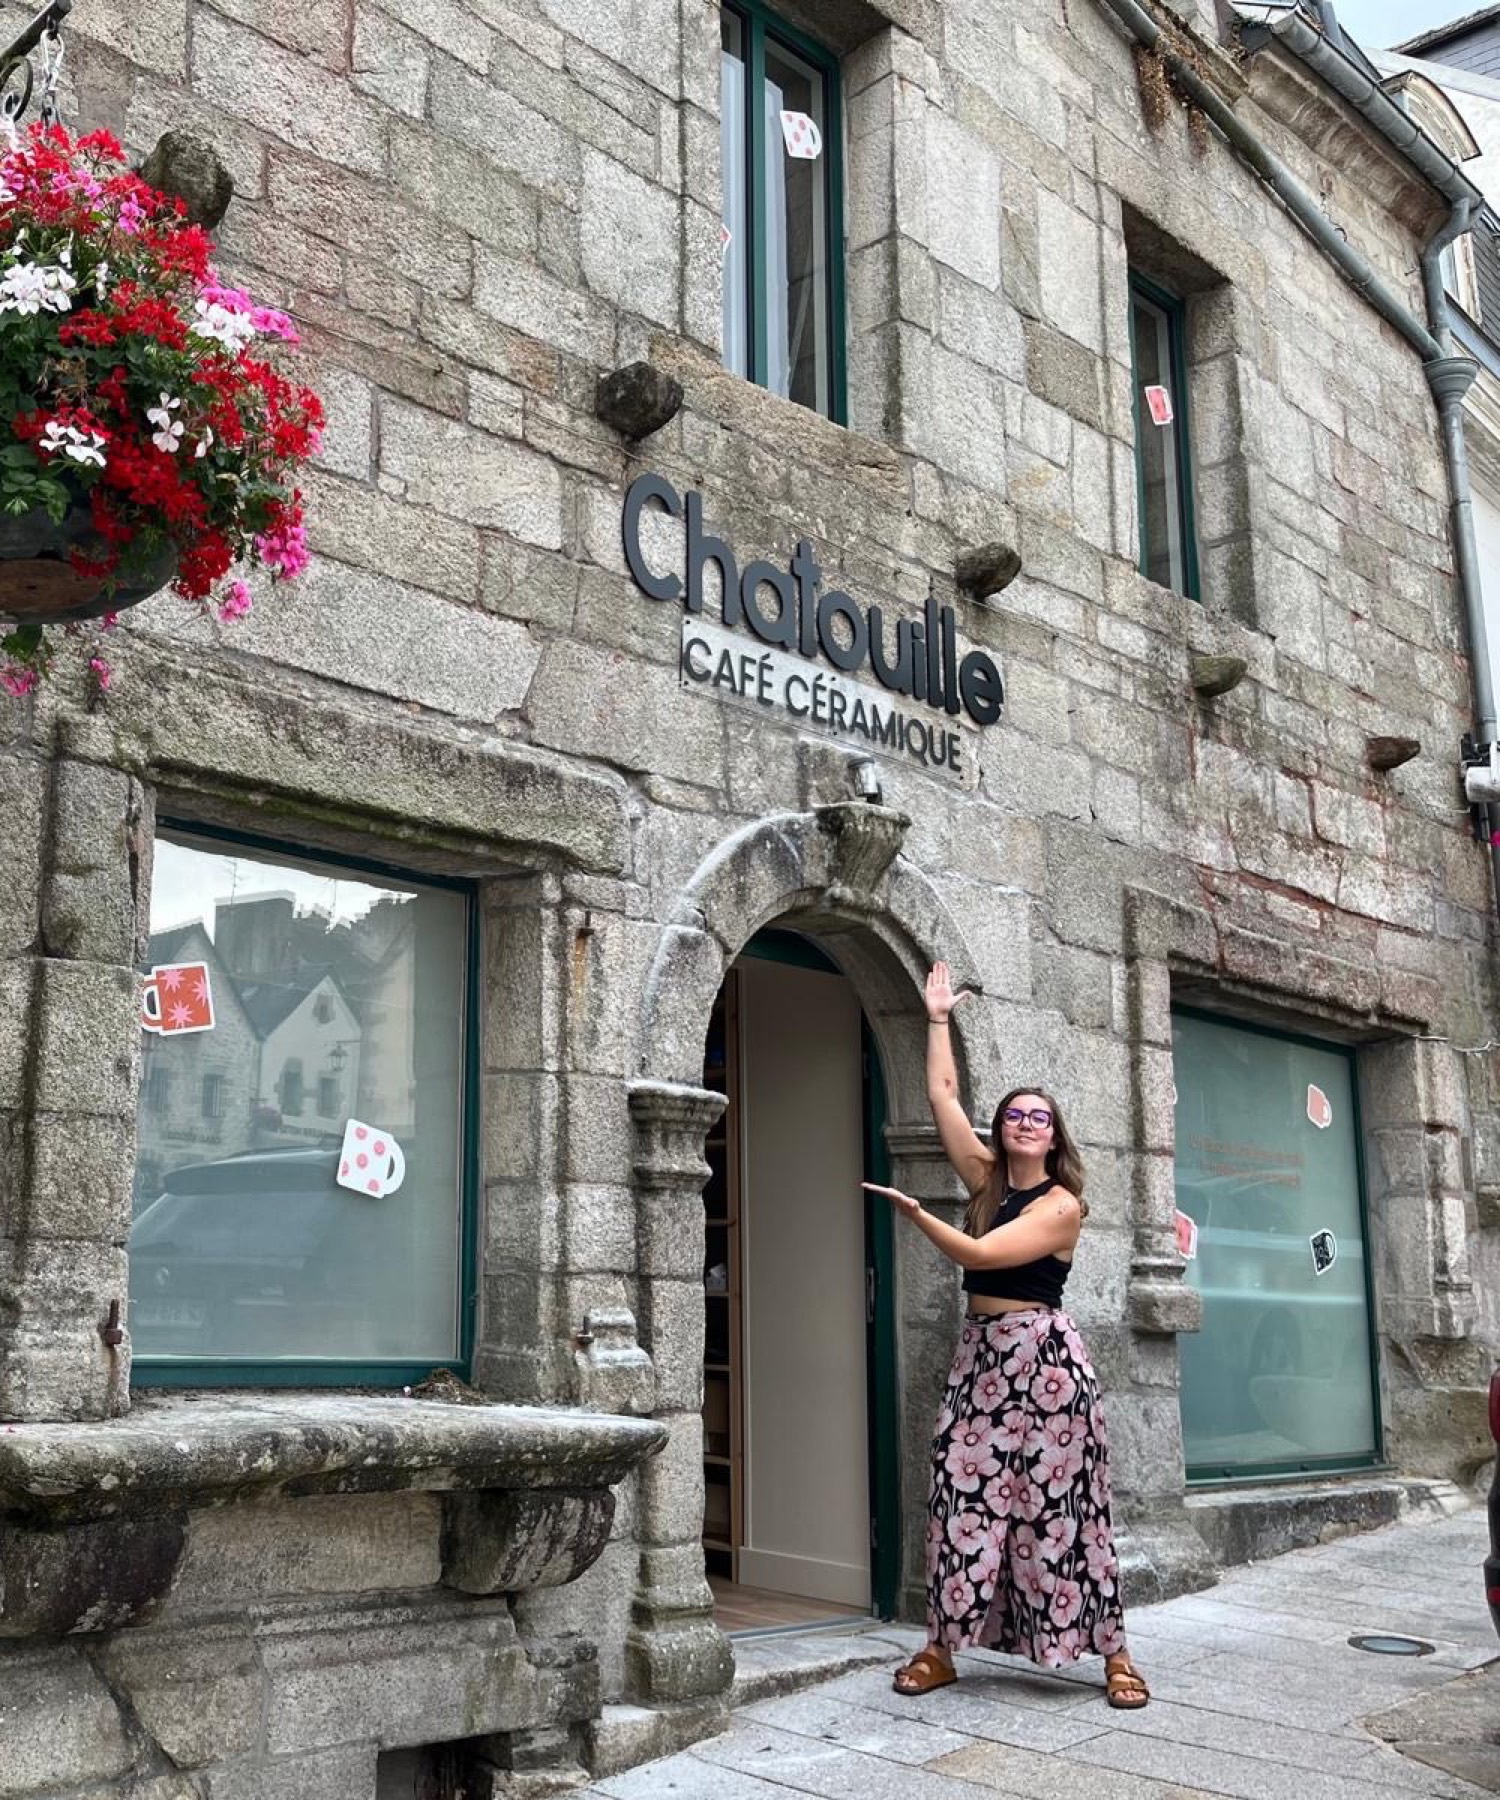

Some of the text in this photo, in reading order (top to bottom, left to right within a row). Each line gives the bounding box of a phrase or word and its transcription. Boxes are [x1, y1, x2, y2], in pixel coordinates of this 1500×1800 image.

[623, 473, 1004, 725] Chatouille
[683, 639, 962, 772] CAFÉ CÉRAMIQUE
